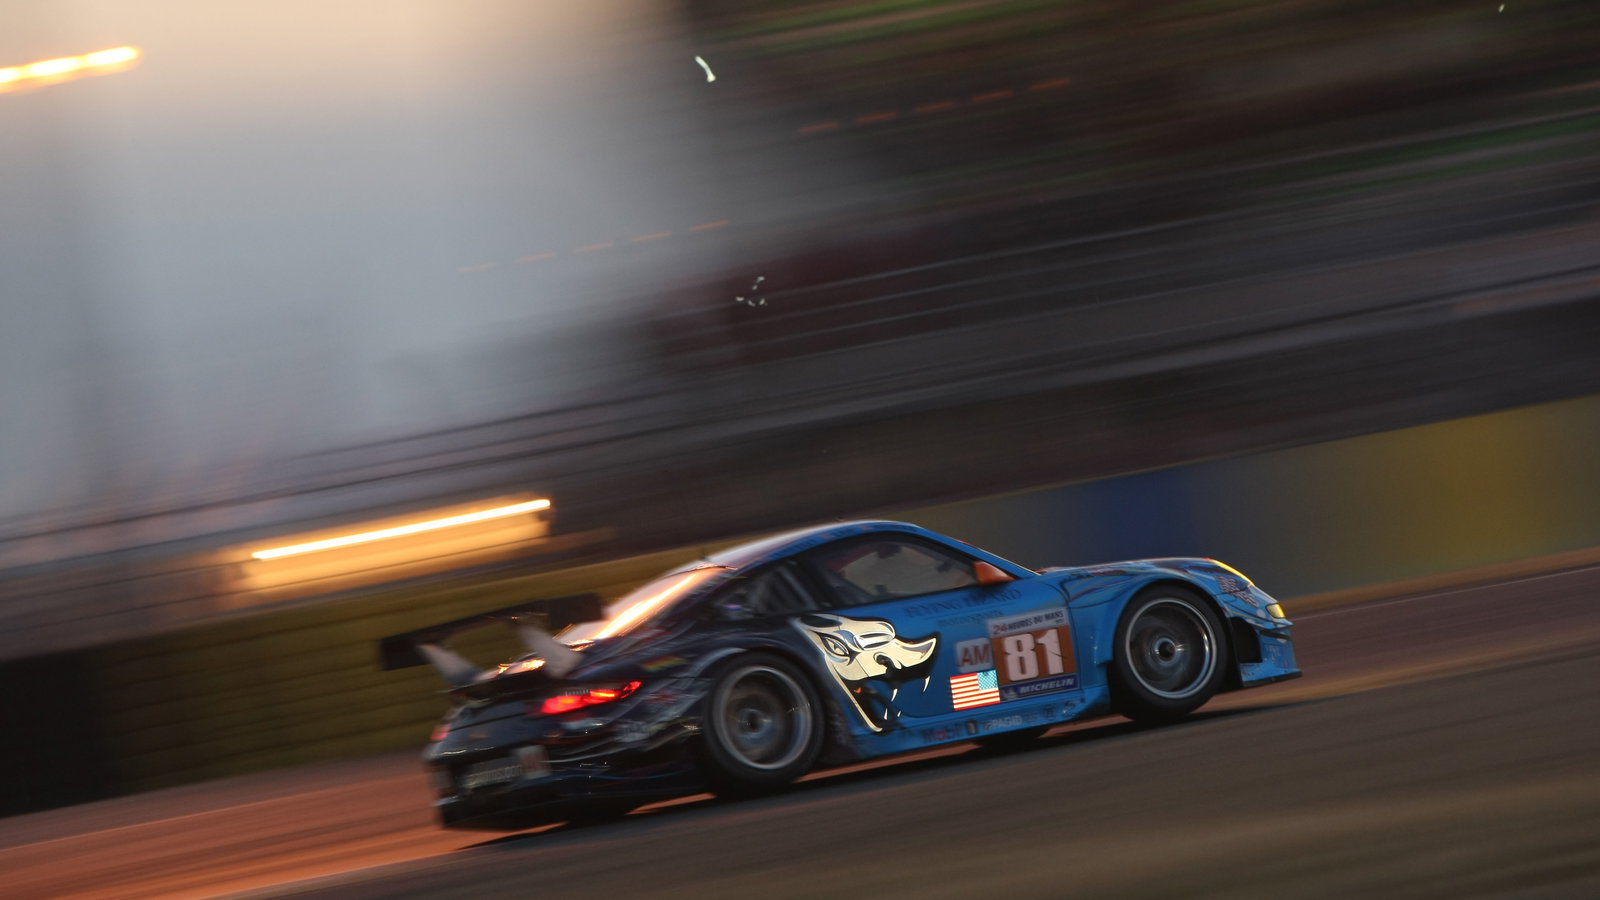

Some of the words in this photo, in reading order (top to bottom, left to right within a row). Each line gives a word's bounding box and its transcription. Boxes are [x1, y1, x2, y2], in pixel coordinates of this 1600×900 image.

[993, 624, 1008, 635] 24
[1045, 610, 1064, 621] MANS
[959, 643, 990, 667] AM
[1004, 628, 1064, 681] 81
[1019, 678, 1075, 694] MICHELIN
